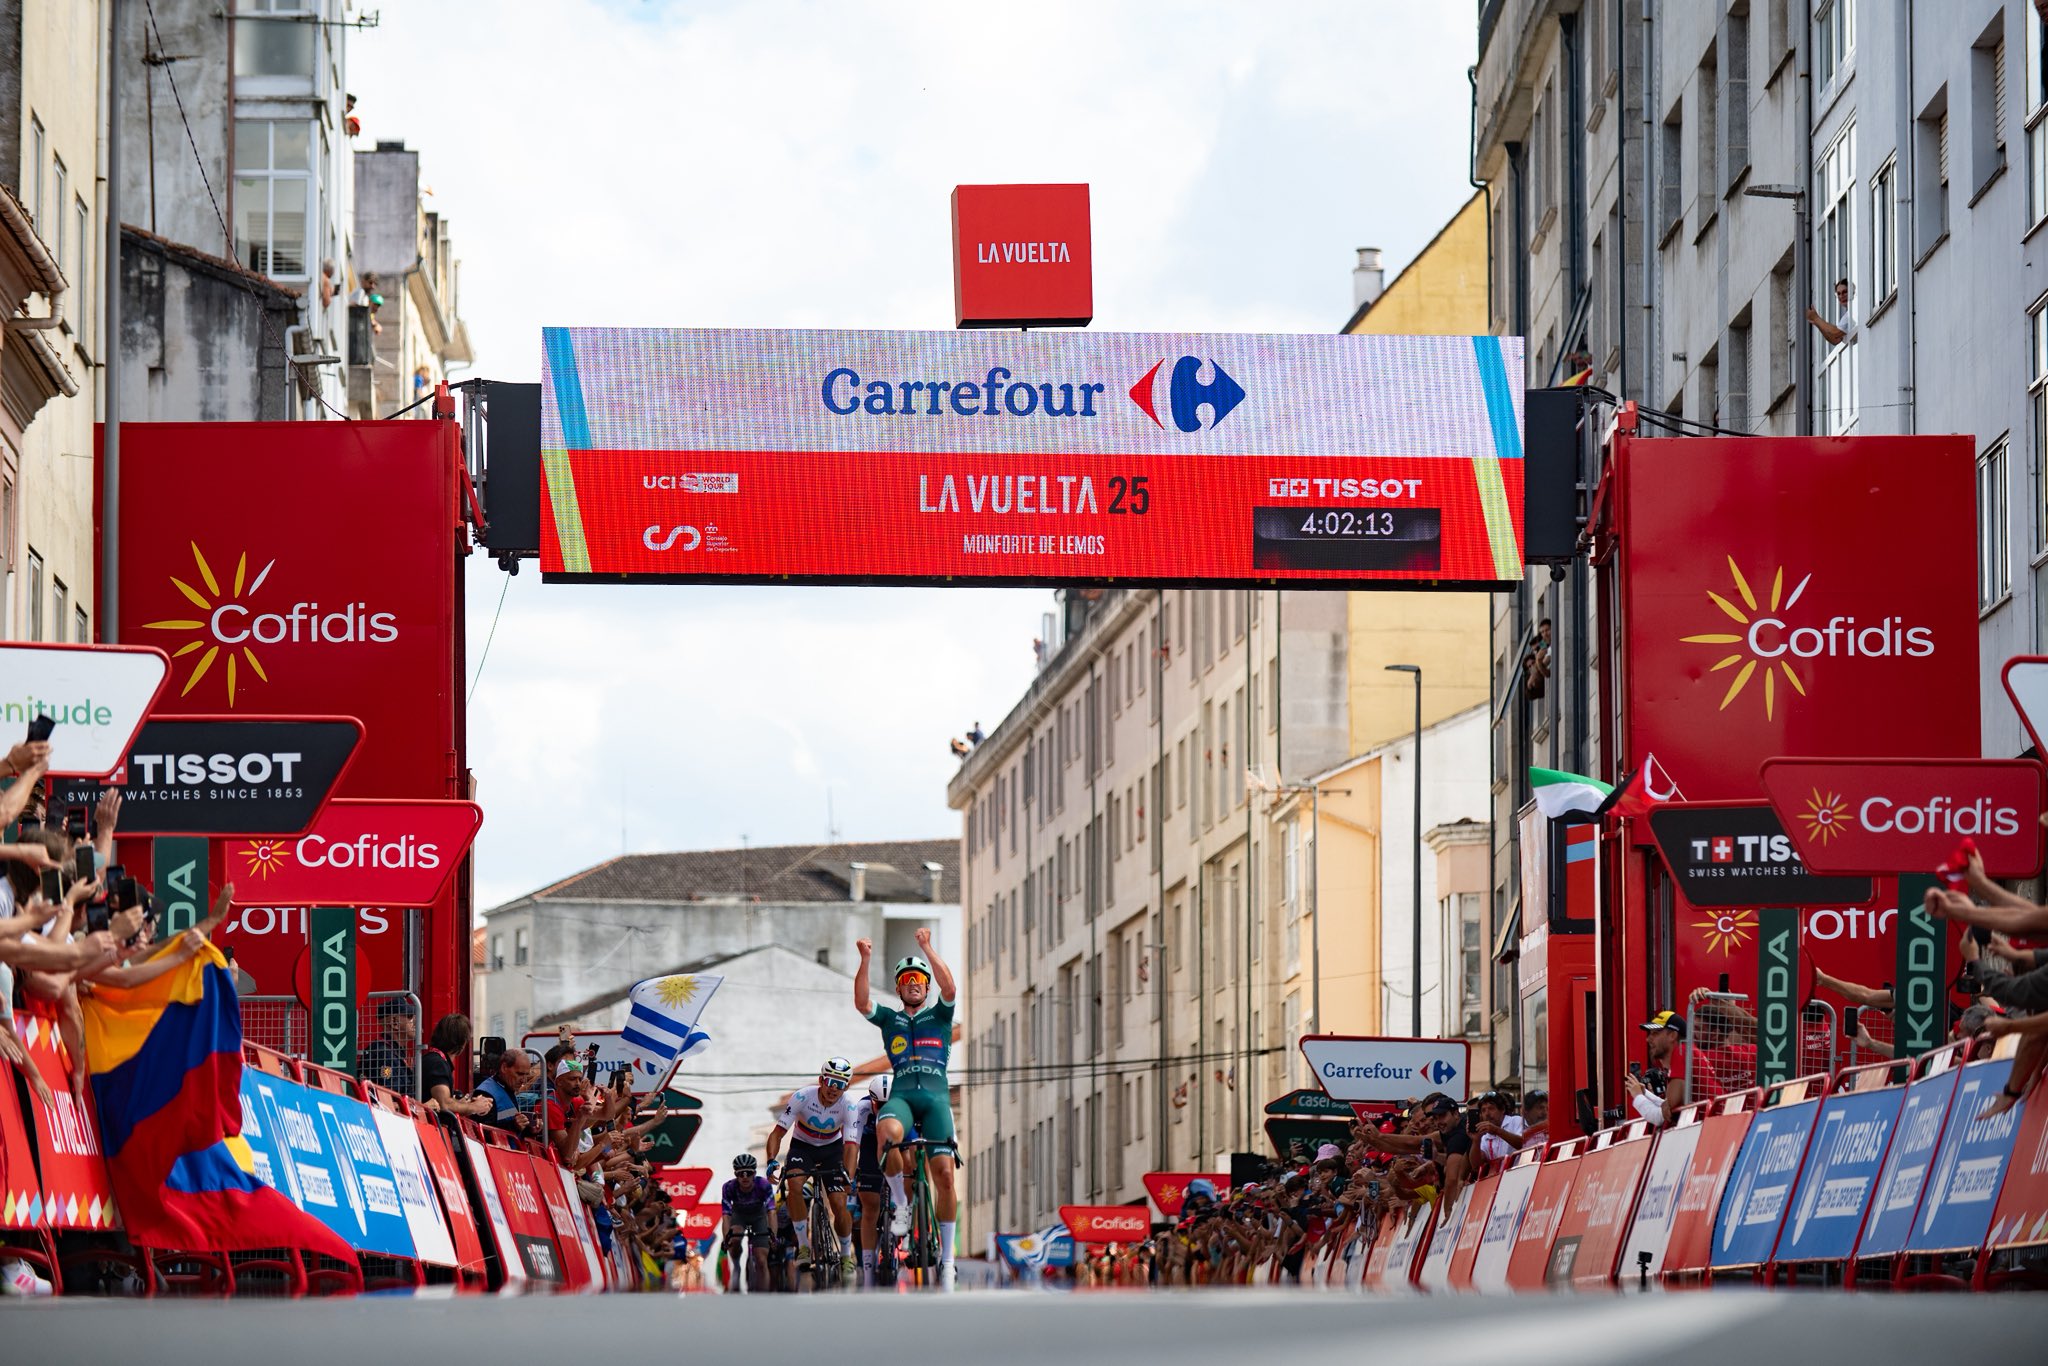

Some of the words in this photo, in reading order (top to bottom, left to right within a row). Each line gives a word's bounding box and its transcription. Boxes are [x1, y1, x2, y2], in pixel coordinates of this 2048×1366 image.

[978, 243, 1000, 263] LA
[1002, 242, 1071, 263] VUELTA
[822, 367, 1105, 417] Carrefour
[643, 475, 676, 489] UCI
[920, 475, 961, 513] LA
[966, 475, 1099, 514] VUELTA
[1108, 476, 1150, 515] 25
[1313, 478, 1423, 499] TISSOT
[1300, 511, 1394, 536] 4:02:13
[963, 534, 1036, 554] MONFORTE
[1039, 535, 1056, 554] DE
[1059, 535, 1105, 555] LEMOS
[211, 602, 399, 644] Cofidis
[1748, 616, 1935, 658] Cofidis
[0, 696, 112, 726] nitude
[134, 753, 302, 785] TISSOT
[68, 790, 107, 802] SWIS
[126, 790, 201, 800] WATCHES
[210, 789, 258, 799] SINCE
[267, 788, 303, 798] 1853
[1860, 796, 2019, 836] Cofidis
[296, 834, 440, 869] Cofidis
[1689, 868, 1725, 878] SWISS
[1731, 867, 1786, 877] WATCHES
[323, 929, 347, 1069] KODA
[1323, 1062, 1413, 1080] Carrefour
[1091, 1216, 1145, 1231] Cofidis
